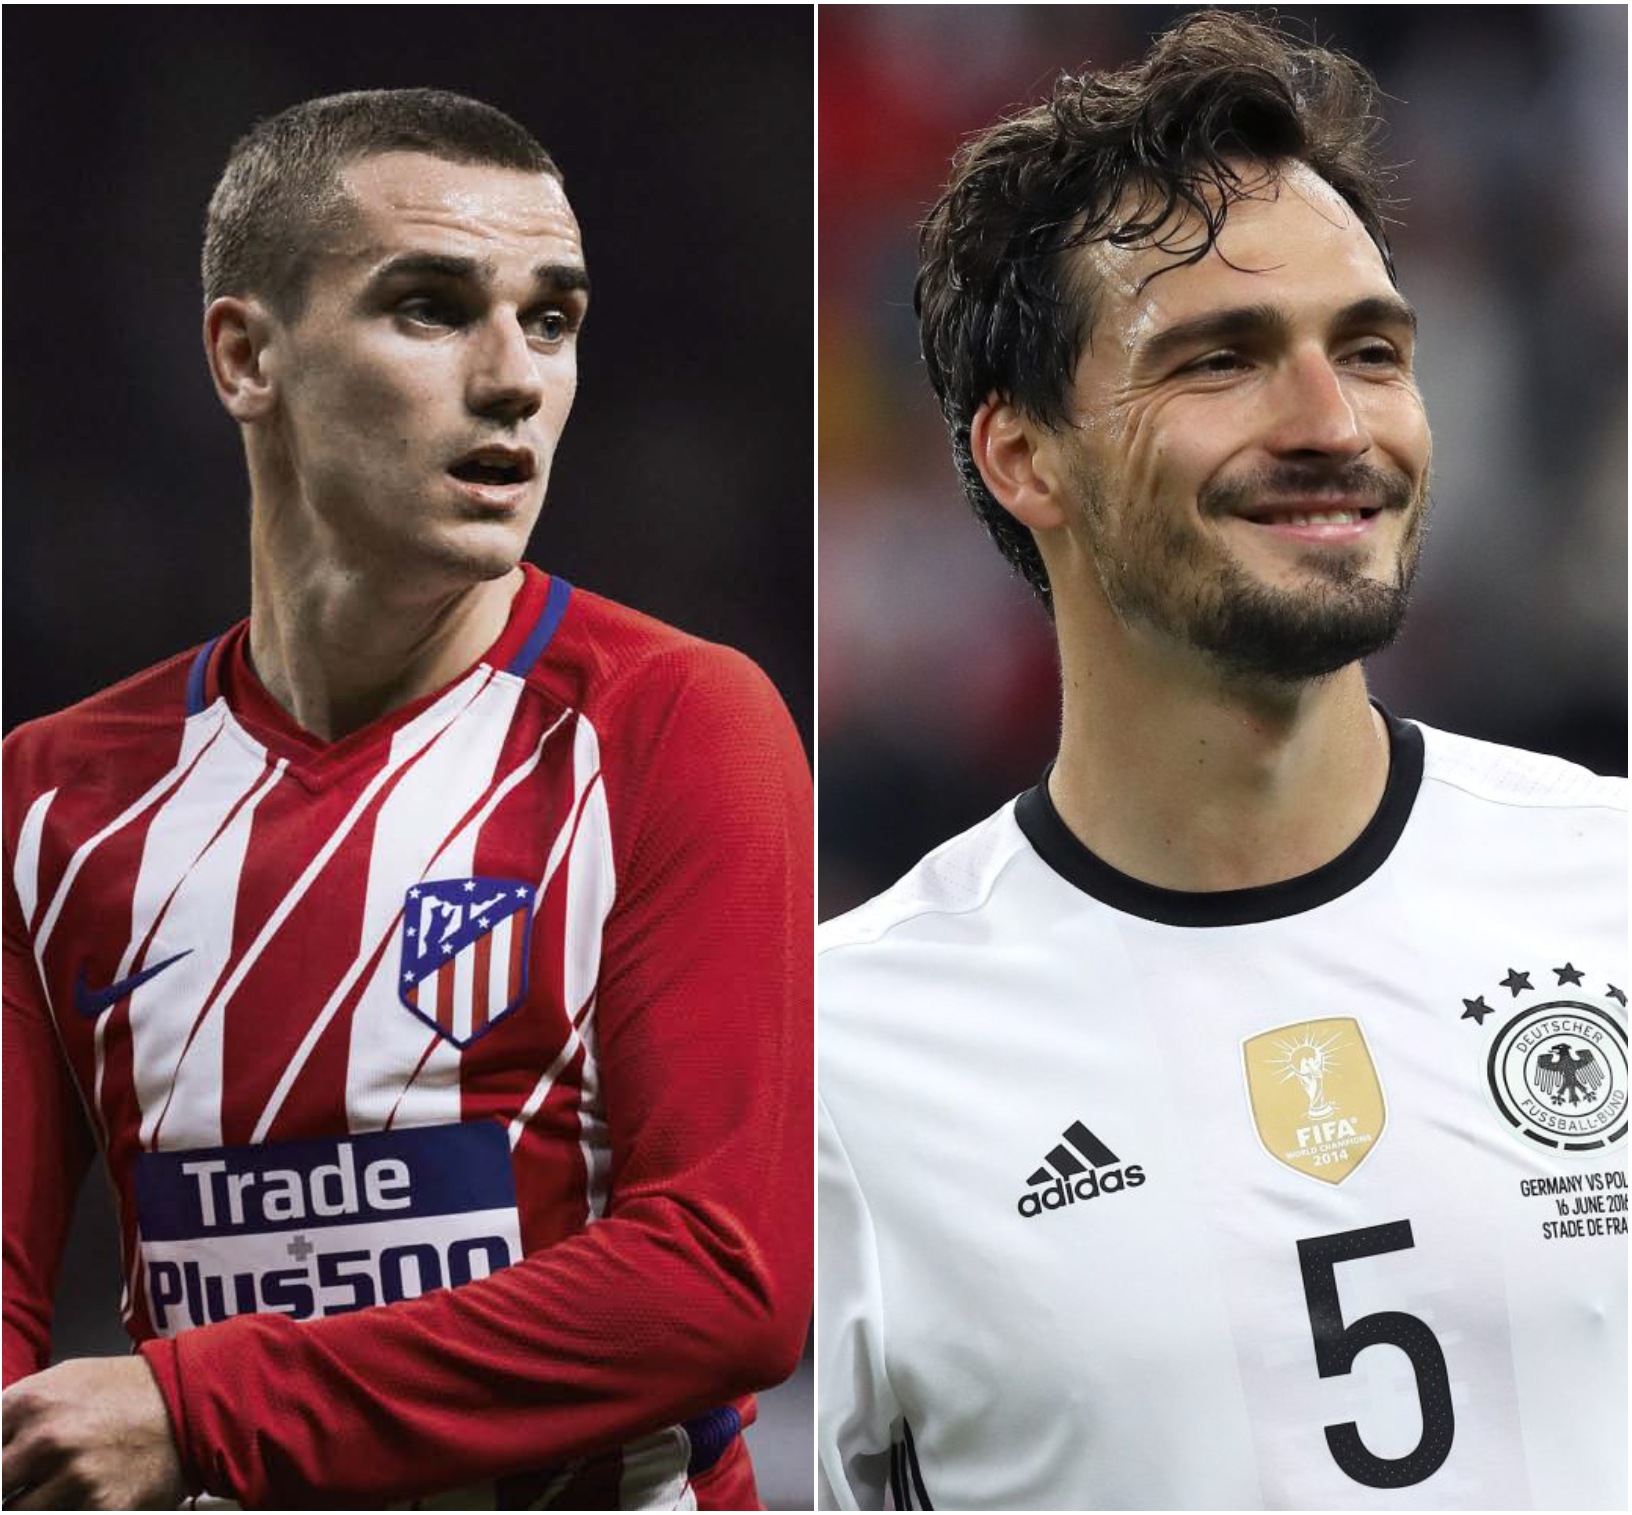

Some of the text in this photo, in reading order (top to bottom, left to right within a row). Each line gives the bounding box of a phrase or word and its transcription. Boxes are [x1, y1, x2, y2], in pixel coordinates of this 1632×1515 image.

[1515, 1020, 1604, 1053] DEUTSCHER
[1521, 1089, 1626, 1131] FUSSBALL-BUND
[1286, 1133, 1372, 1159] WORLD CHAMPIONS
[1296, 1119, 1357, 1149] FIFA
[1313, 1149, 1349, 1166] 2014
[181, 1142, 412, 1227] Trade
[1017, 1164, 1146, 1218] adidas
[1520, 1171, 1629, 1198] GERMANY VS POL
[1555, 1198, 1570, 1216] 16
[1572, 1195, 1605, 1215] JUNE
[1542, 1216, 1629, 1240] STADE DE FRA
[148, 1236, 510, 1329] Plus500
[1296, 1219, 1455, 1489] 5
